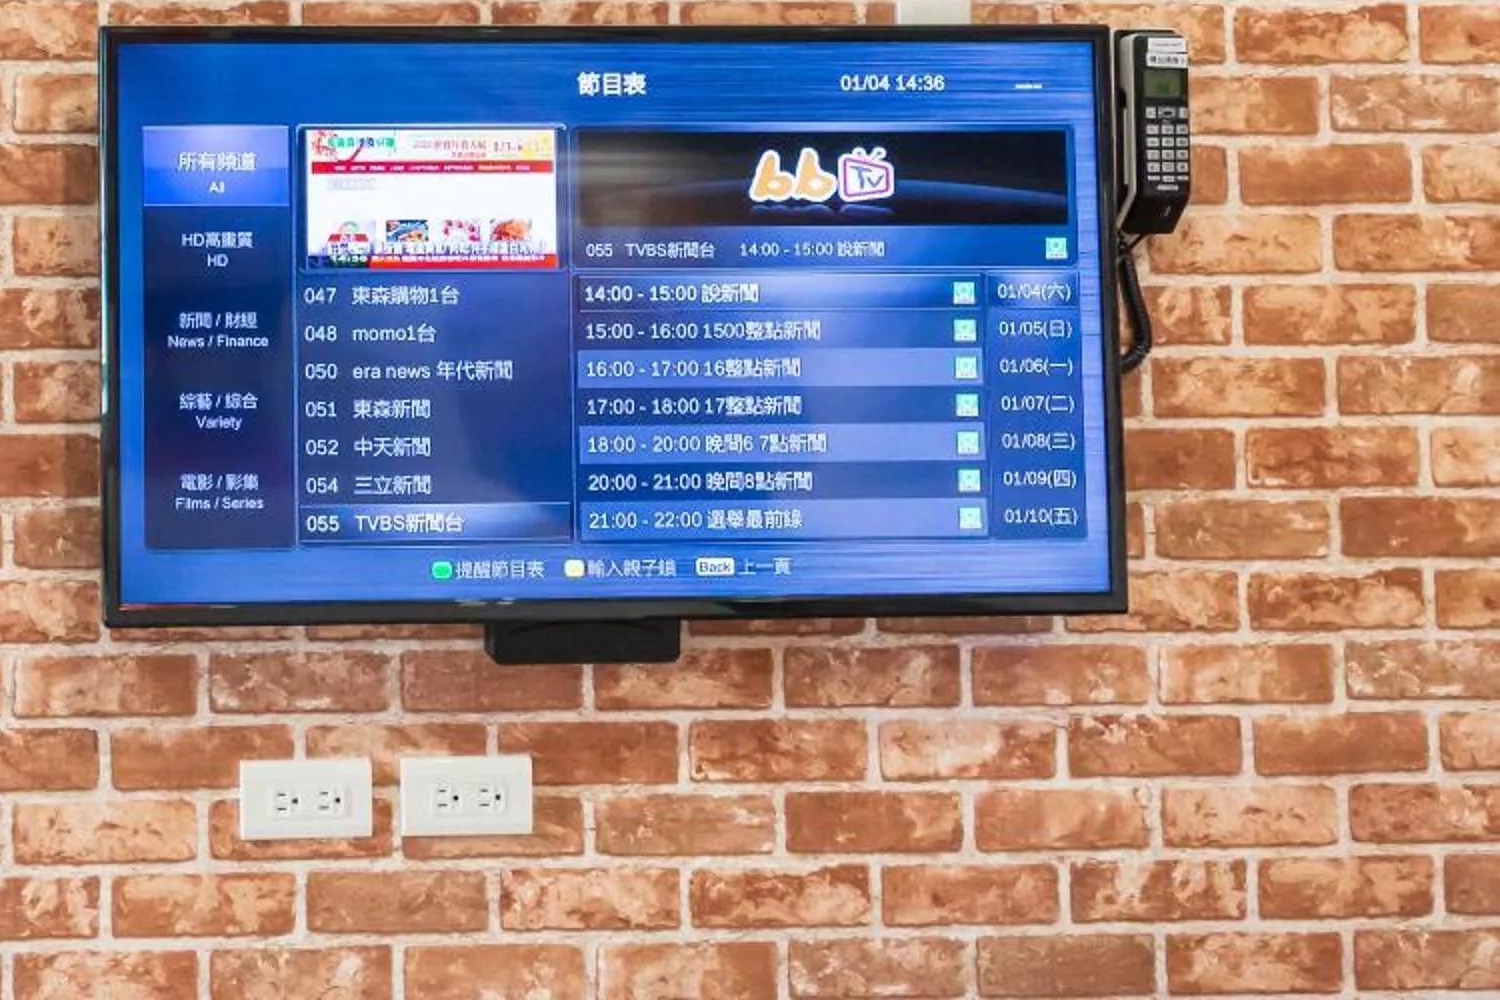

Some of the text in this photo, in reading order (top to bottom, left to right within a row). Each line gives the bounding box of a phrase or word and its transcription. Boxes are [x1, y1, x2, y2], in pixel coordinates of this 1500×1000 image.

[577, 72, 647, 95] 節目表
[840, 74, 944, 91] 01/04 14:36
[178, 152, 256, 172] 所有頻道
[207, 253, 229, 267] HD
[586, 243, 613, 258] 055
[625, 242, 716, 259] TVBS新聞台
[740, 243, 779, 257] 14:00
[795, 243, 833, 257] 15:00
[304, 286, 337, 304] 047
[584, 285, 633, 302] 14:00
[650, 285, 697, 302] 15:00
[997, 282, 1071, 300] 01/04(六)
[179, 312, 212, 328] 新聞
[999, 319, 1072, 338] 01/05(日)
[167, 335, 204, 348] News
[217, 334, 269, 347] Finance
[304, 323, 437, 343] 048 momo1台
[585, 323, 633, 340] 15:00
[650, 323, 698, 340] 16:00
[304, 360, 514, 381] 050 era news 年代新聞
[586, 361, 635, 377] 16:00
[651, 360, 699, 377] 17:00
[999, 357, 1073, 376] 01/06(一)
[305, 399, 431, 419] 051 東森新聞
[587, 399, 635, 415] 17:00
[651, 399, 699, 415] 18:00
[1001, 395, 1075, 414] 01/07(二)
[195, 415, 243, 430] Variety
[305, 437, 431, 457] 052 中天新聞
[587, 436, 636, 453] 18:00
[653, 436, 700, 453] 20:00
[760, 433, 827, 453] 7點新聞
[1001, 432, 1075, 451] 01/08(三)
[180, 473, 213, 490] 電影
[306, 475, 431, 495] 054 三立新聞
[587, 474, 637, 491] 20:00
[653, 474, 701, 491] 21:00
[706, 471, 813, 492] 晚間8點新聞
[1003, 469, 1077, 488] 01/09(四)
[175, 498, 211, 510] Films
[222, 497, 264, 509] Series
[307, 513, 465, 533] 055 TVBS新聞台
[589, 512, 637, 529] 21:00
[654, 511, 702, 529] 22:00
[1004, 507, 1078, 526] 01/10(五)
[456, 560, 545, 580] 提醒節目表
[698, 558, 792, 576] Back 上一頁
